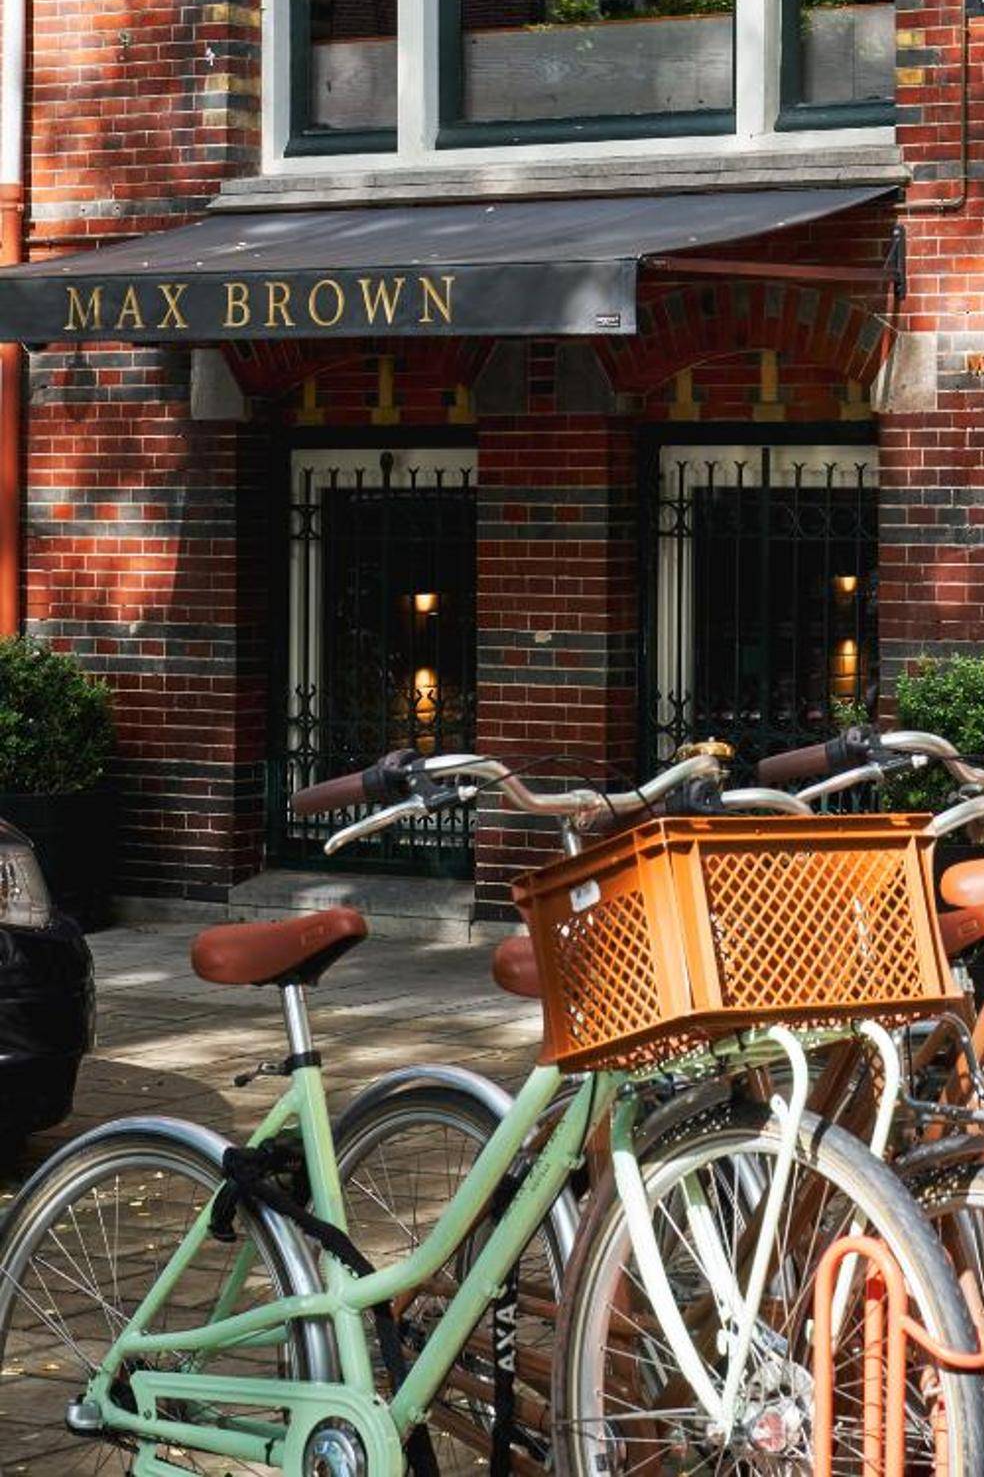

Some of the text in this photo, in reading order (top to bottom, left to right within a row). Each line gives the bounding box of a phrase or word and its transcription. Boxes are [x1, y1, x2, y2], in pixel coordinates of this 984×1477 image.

[63, 275, 456, 332] MAX BROWN
[496, 1303, 518, 1373] AXA
